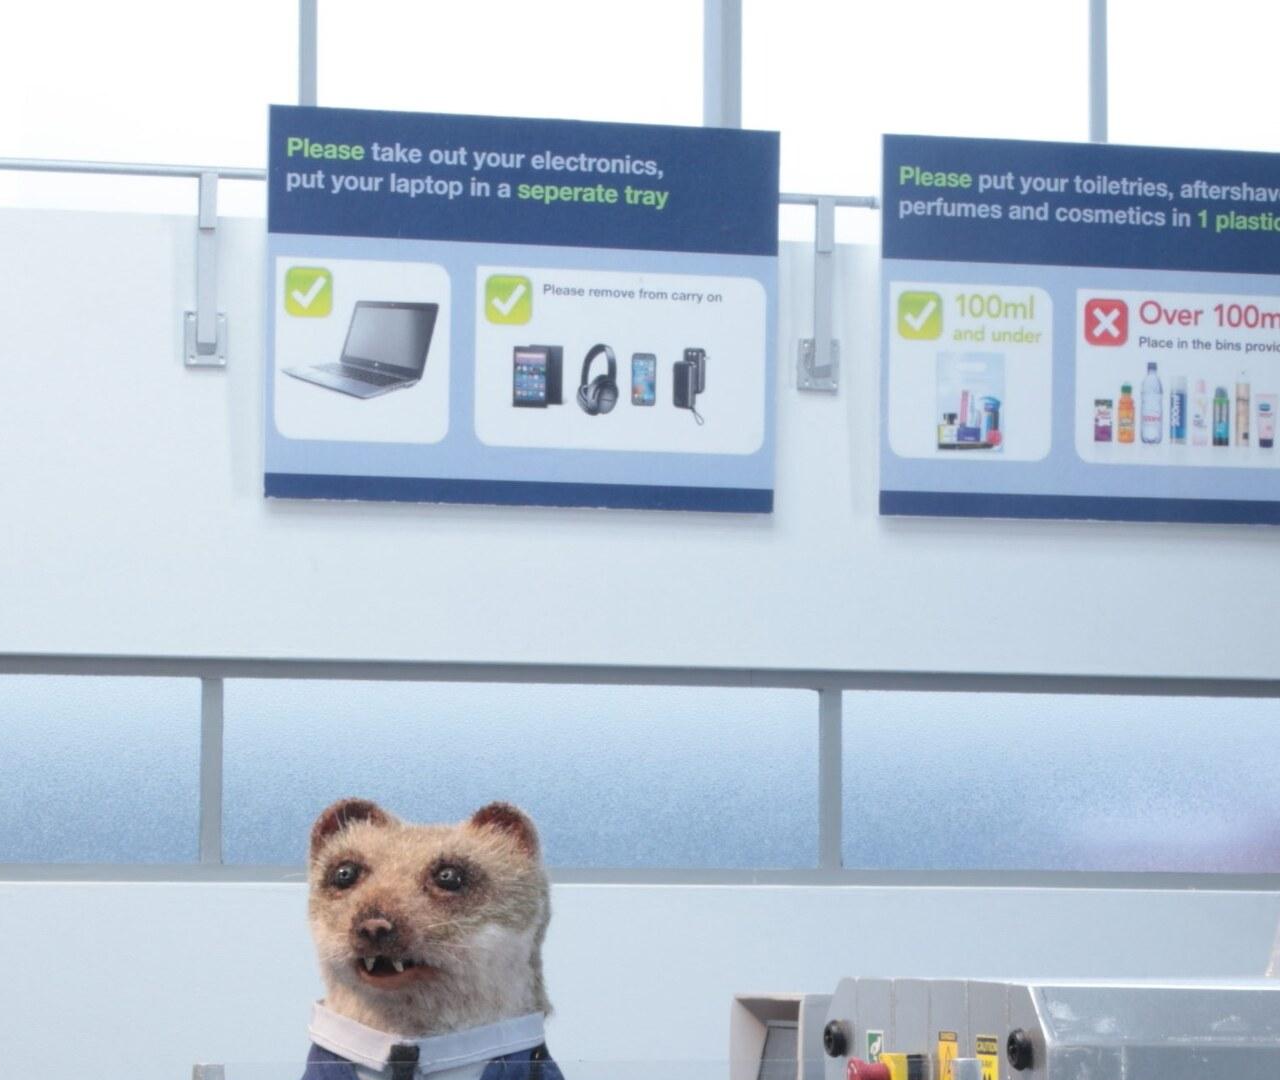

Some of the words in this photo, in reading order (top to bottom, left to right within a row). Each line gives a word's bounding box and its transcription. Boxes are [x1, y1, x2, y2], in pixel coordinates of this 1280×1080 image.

[286, 137, 365, 161] Please
[371, 141, 422, 164] take
[429, 147, 467, 165] out
[473, 152, 525, 170] your
[531, 151, 664, 179] electronics,
[286, 171, 325, 191] put
[331, 176, 383, 193] your
[390, 174, 463, 199] laptop
[470, 178, 490, 197] in
[497, 184, 511, 198] a
[518, 183, 618, 204] seperate
[624, 186, 668, 209] tray
[899, 166, 972, 188] Please
[978, 171, 1014, 193] put
[1020, 175, 1068, 195] your
[1074, 176, 1174, 201] toiletries,
[899, 199, 1002, 219] perfumes
[1008, 202, 1048, 222] and
[1055, 205, 1165, 226] cosmetics
[1172, 208, 1191, 227] in
[1198, 209, 1207, 228] 1
[543, 284, 584, 296] Please
[589, 288, 635, 299] remove
[638, 288, 668, 301] from
[671, 292, 702, 303] carry
[706, 293, 722, 302] on
[955, 294, 1035, 318] 100ml
[1139, 300, 1204, 327] Over
[953, 326, 984, 341] and
[992, 327, 1041, 342] under
[1139, 337, 1172, 349] Place
[1176, 339, 1188, 350] in
[1192, 338, 1211, 351] the
[1216, 340, 1241, 352] bins
